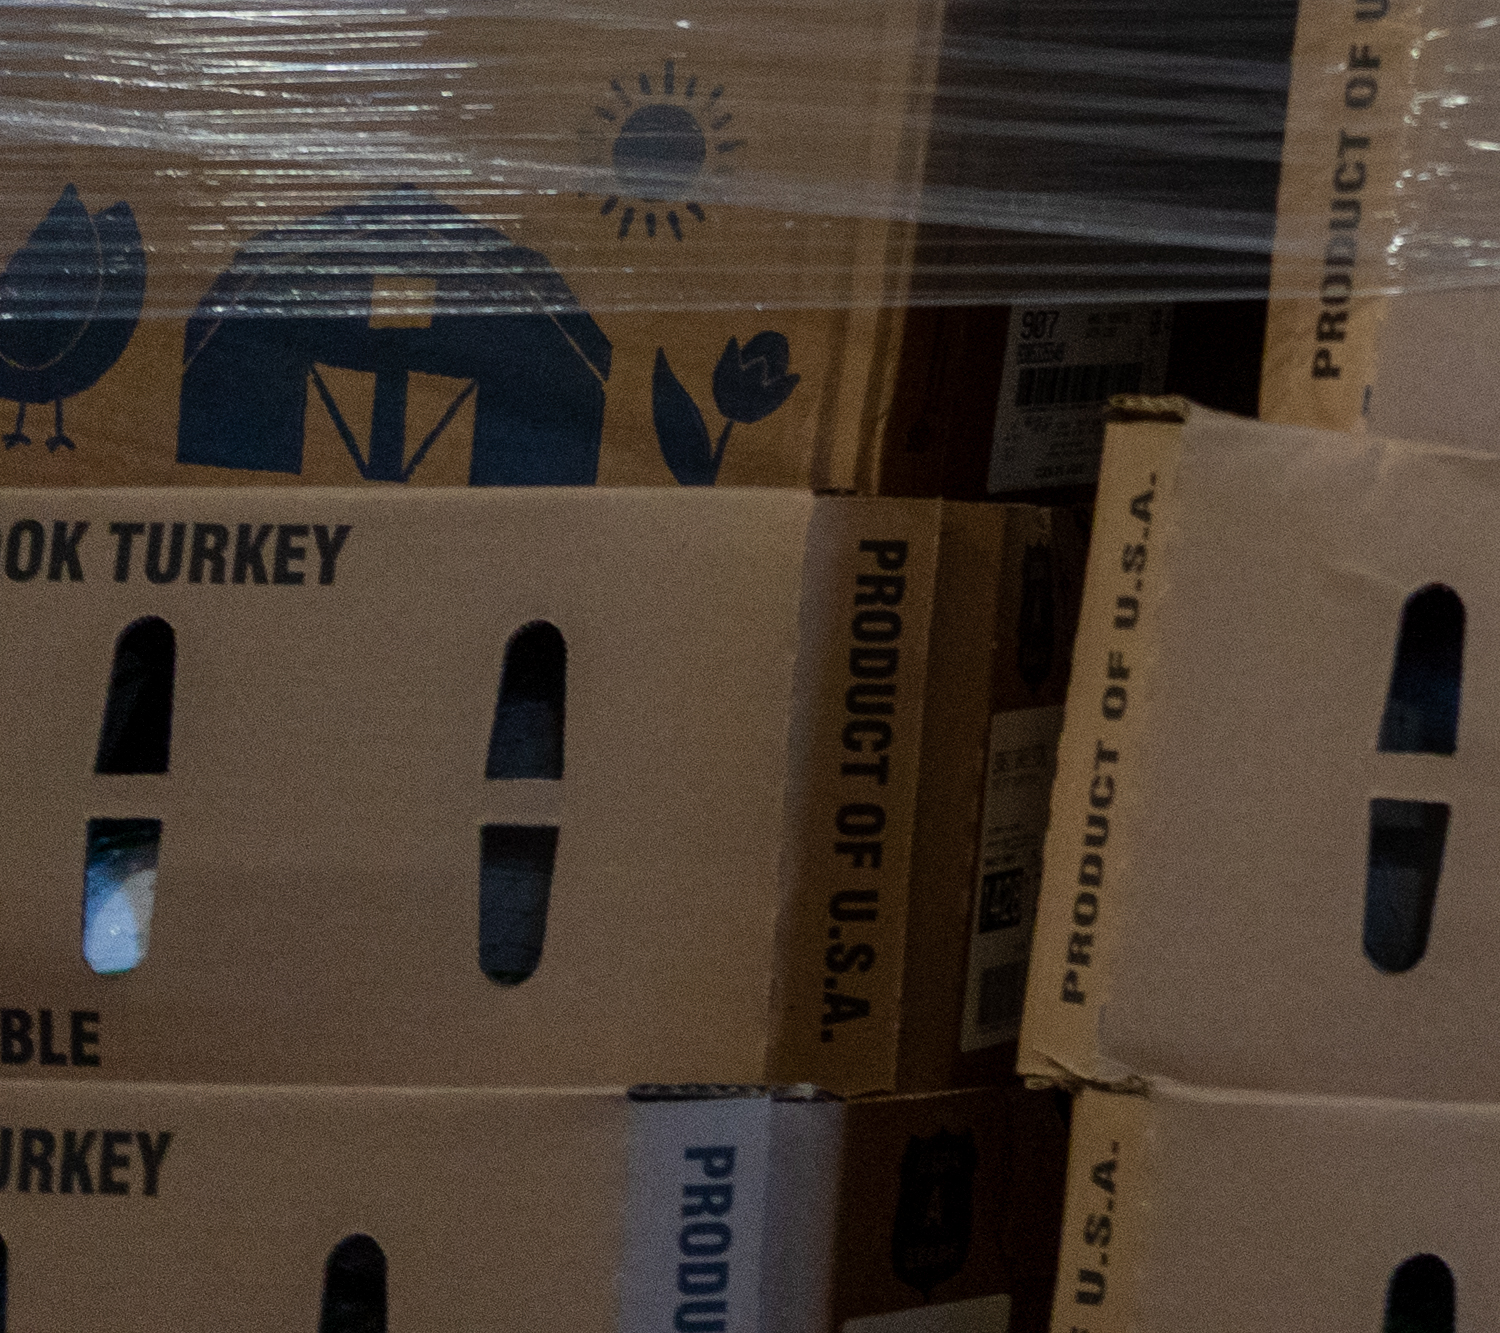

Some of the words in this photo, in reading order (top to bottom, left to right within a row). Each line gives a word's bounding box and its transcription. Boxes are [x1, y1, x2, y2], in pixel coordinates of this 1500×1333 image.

[1310, 129, 1372, 382] PRODUCT
[1345, 43, 1383, 111] OF
[0, 520, 91, 586] OK
[110, 522, 353, 588] TURKEY
[1113, 472, 1158, 631] U.S.A.
[833, 537, 910, 785] PRODUCT
[1101, 650, 1132, 721] OF
[831, 799, 888, 870] OF
[1060, 739, 1120, 1007] PRODUCT
[816, 883, 878, 1045] U.S.A.
[1073, 1137, 1121, 1308] U.S.A.
